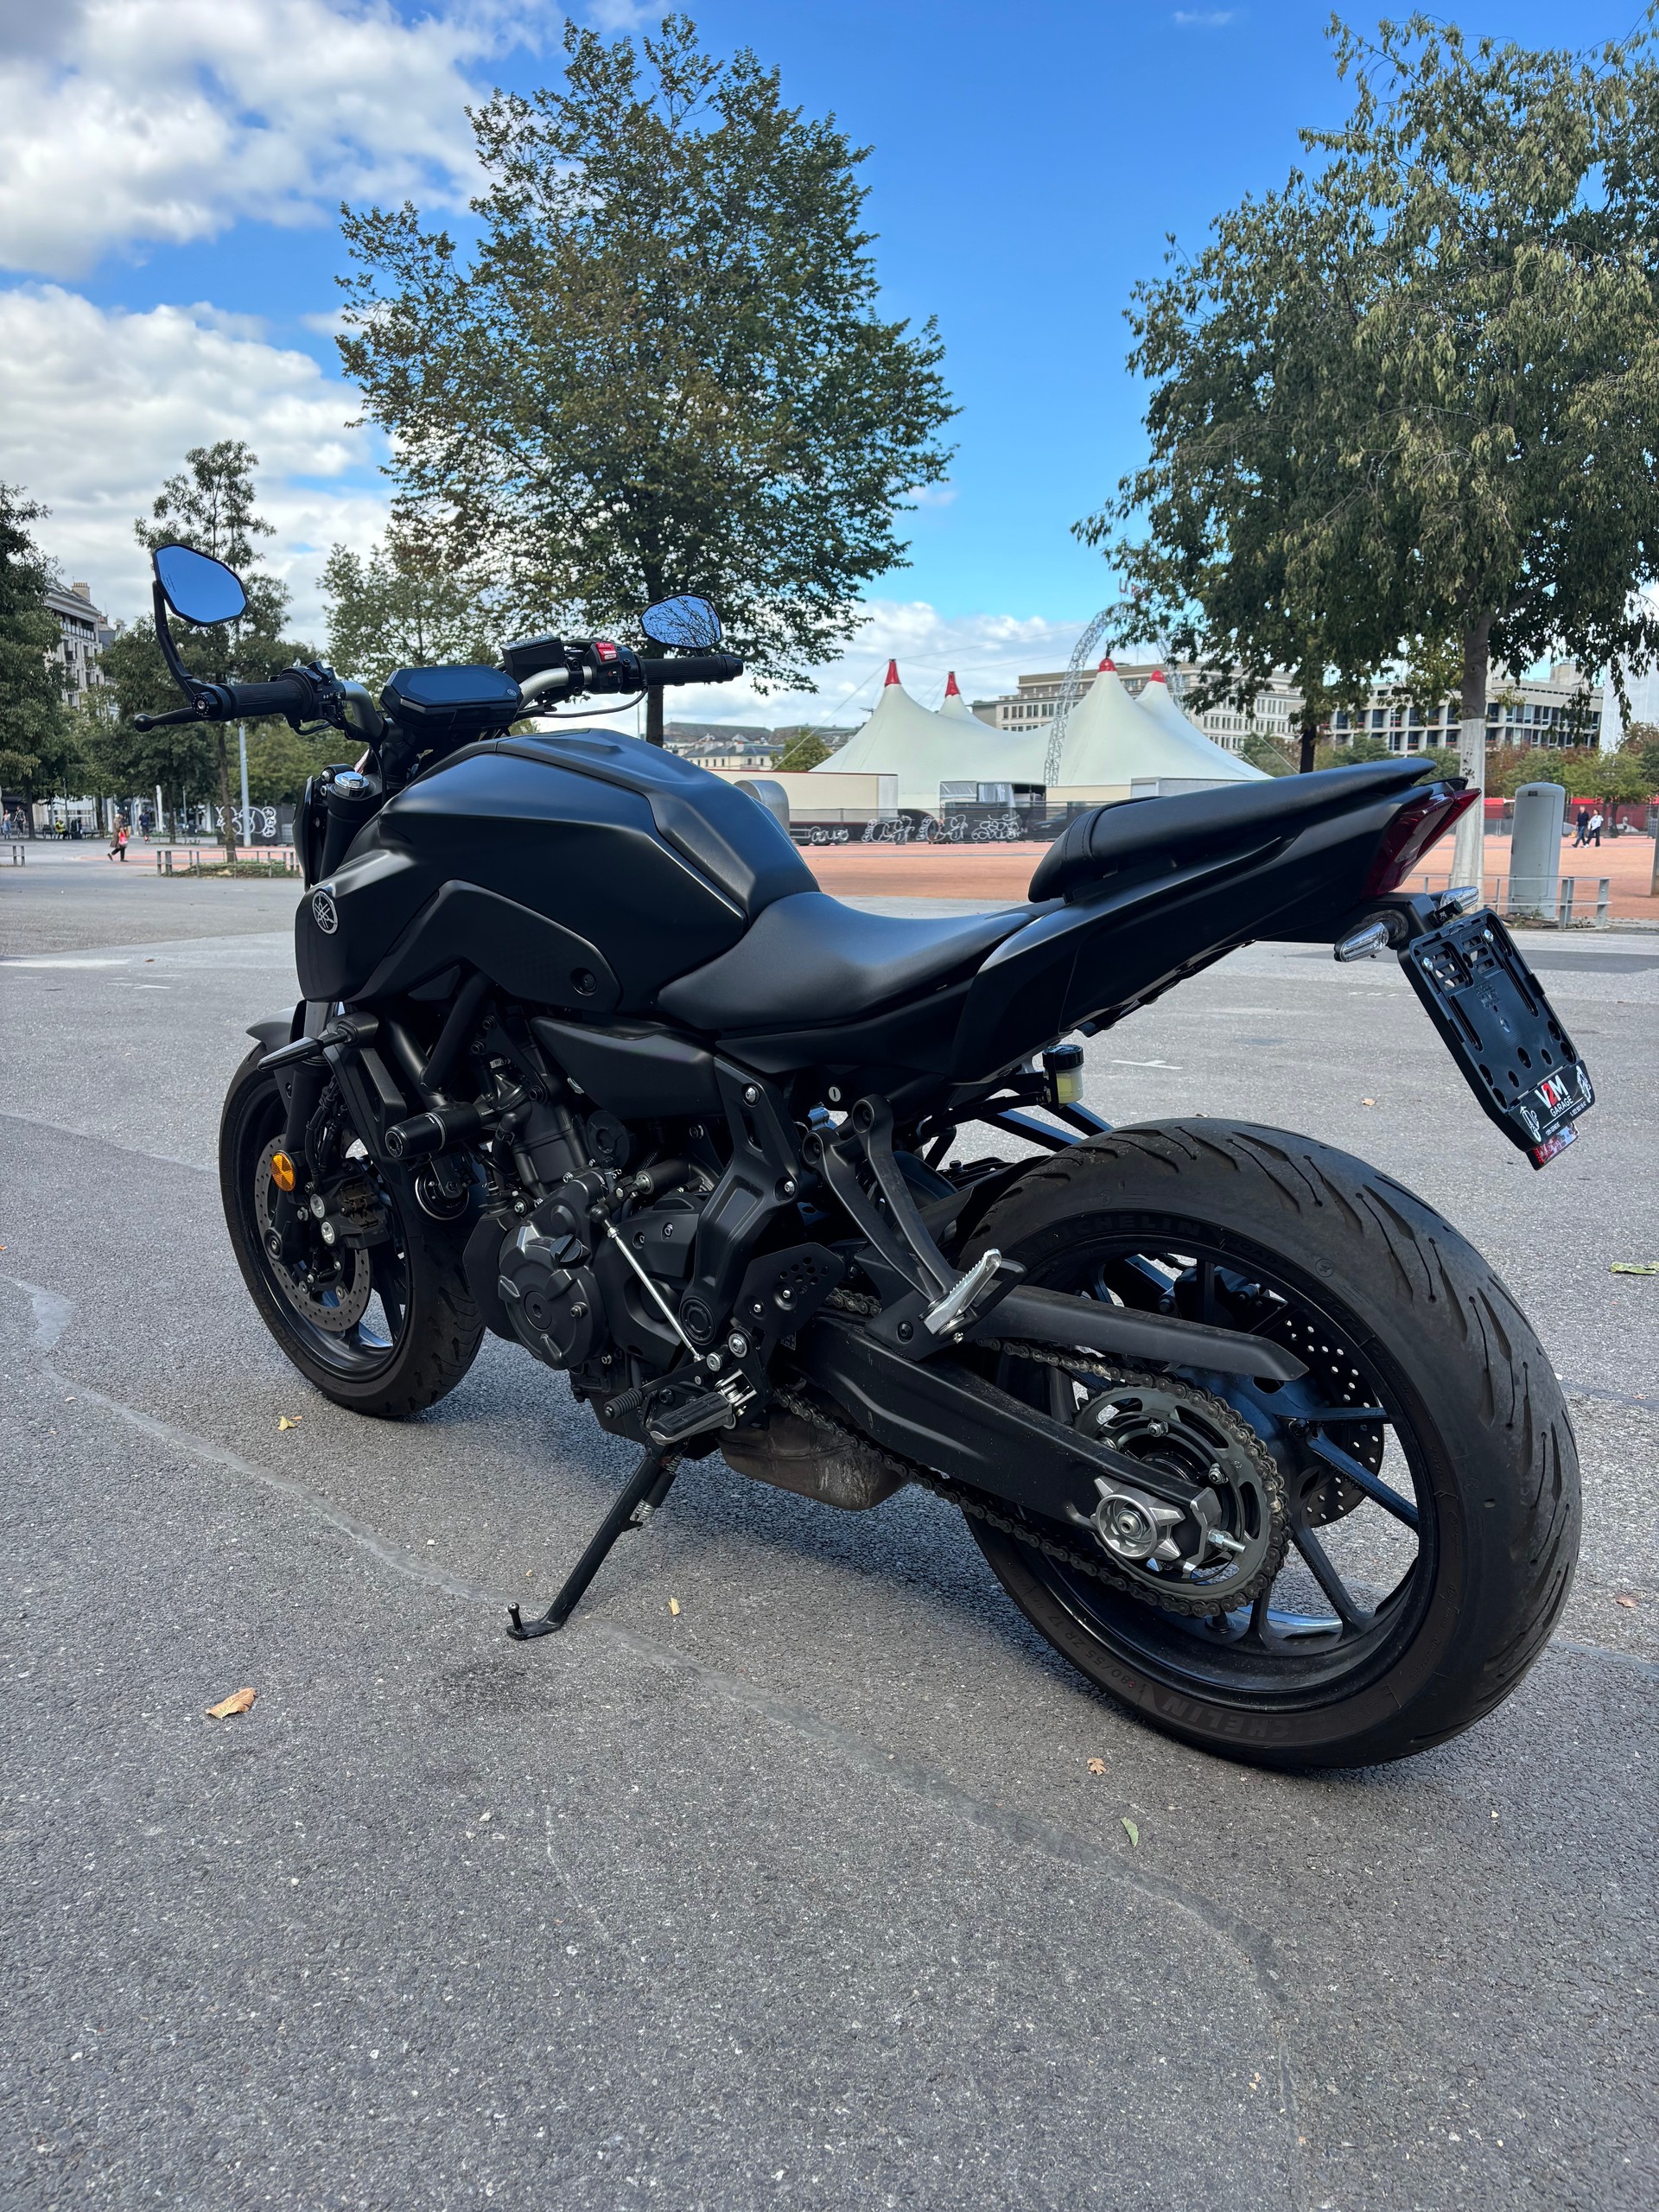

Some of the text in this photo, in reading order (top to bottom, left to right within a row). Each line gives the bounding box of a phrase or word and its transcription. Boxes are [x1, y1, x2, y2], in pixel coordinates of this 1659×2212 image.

[1535, 1075, 1568, 1109] V2M
[1550, 1096, 1573, 1116] GARAGE
[1047, 1614, 1135, 1688] 80/55 ZR 17
[1161, 1695, 1332, 1738] CHELIN
